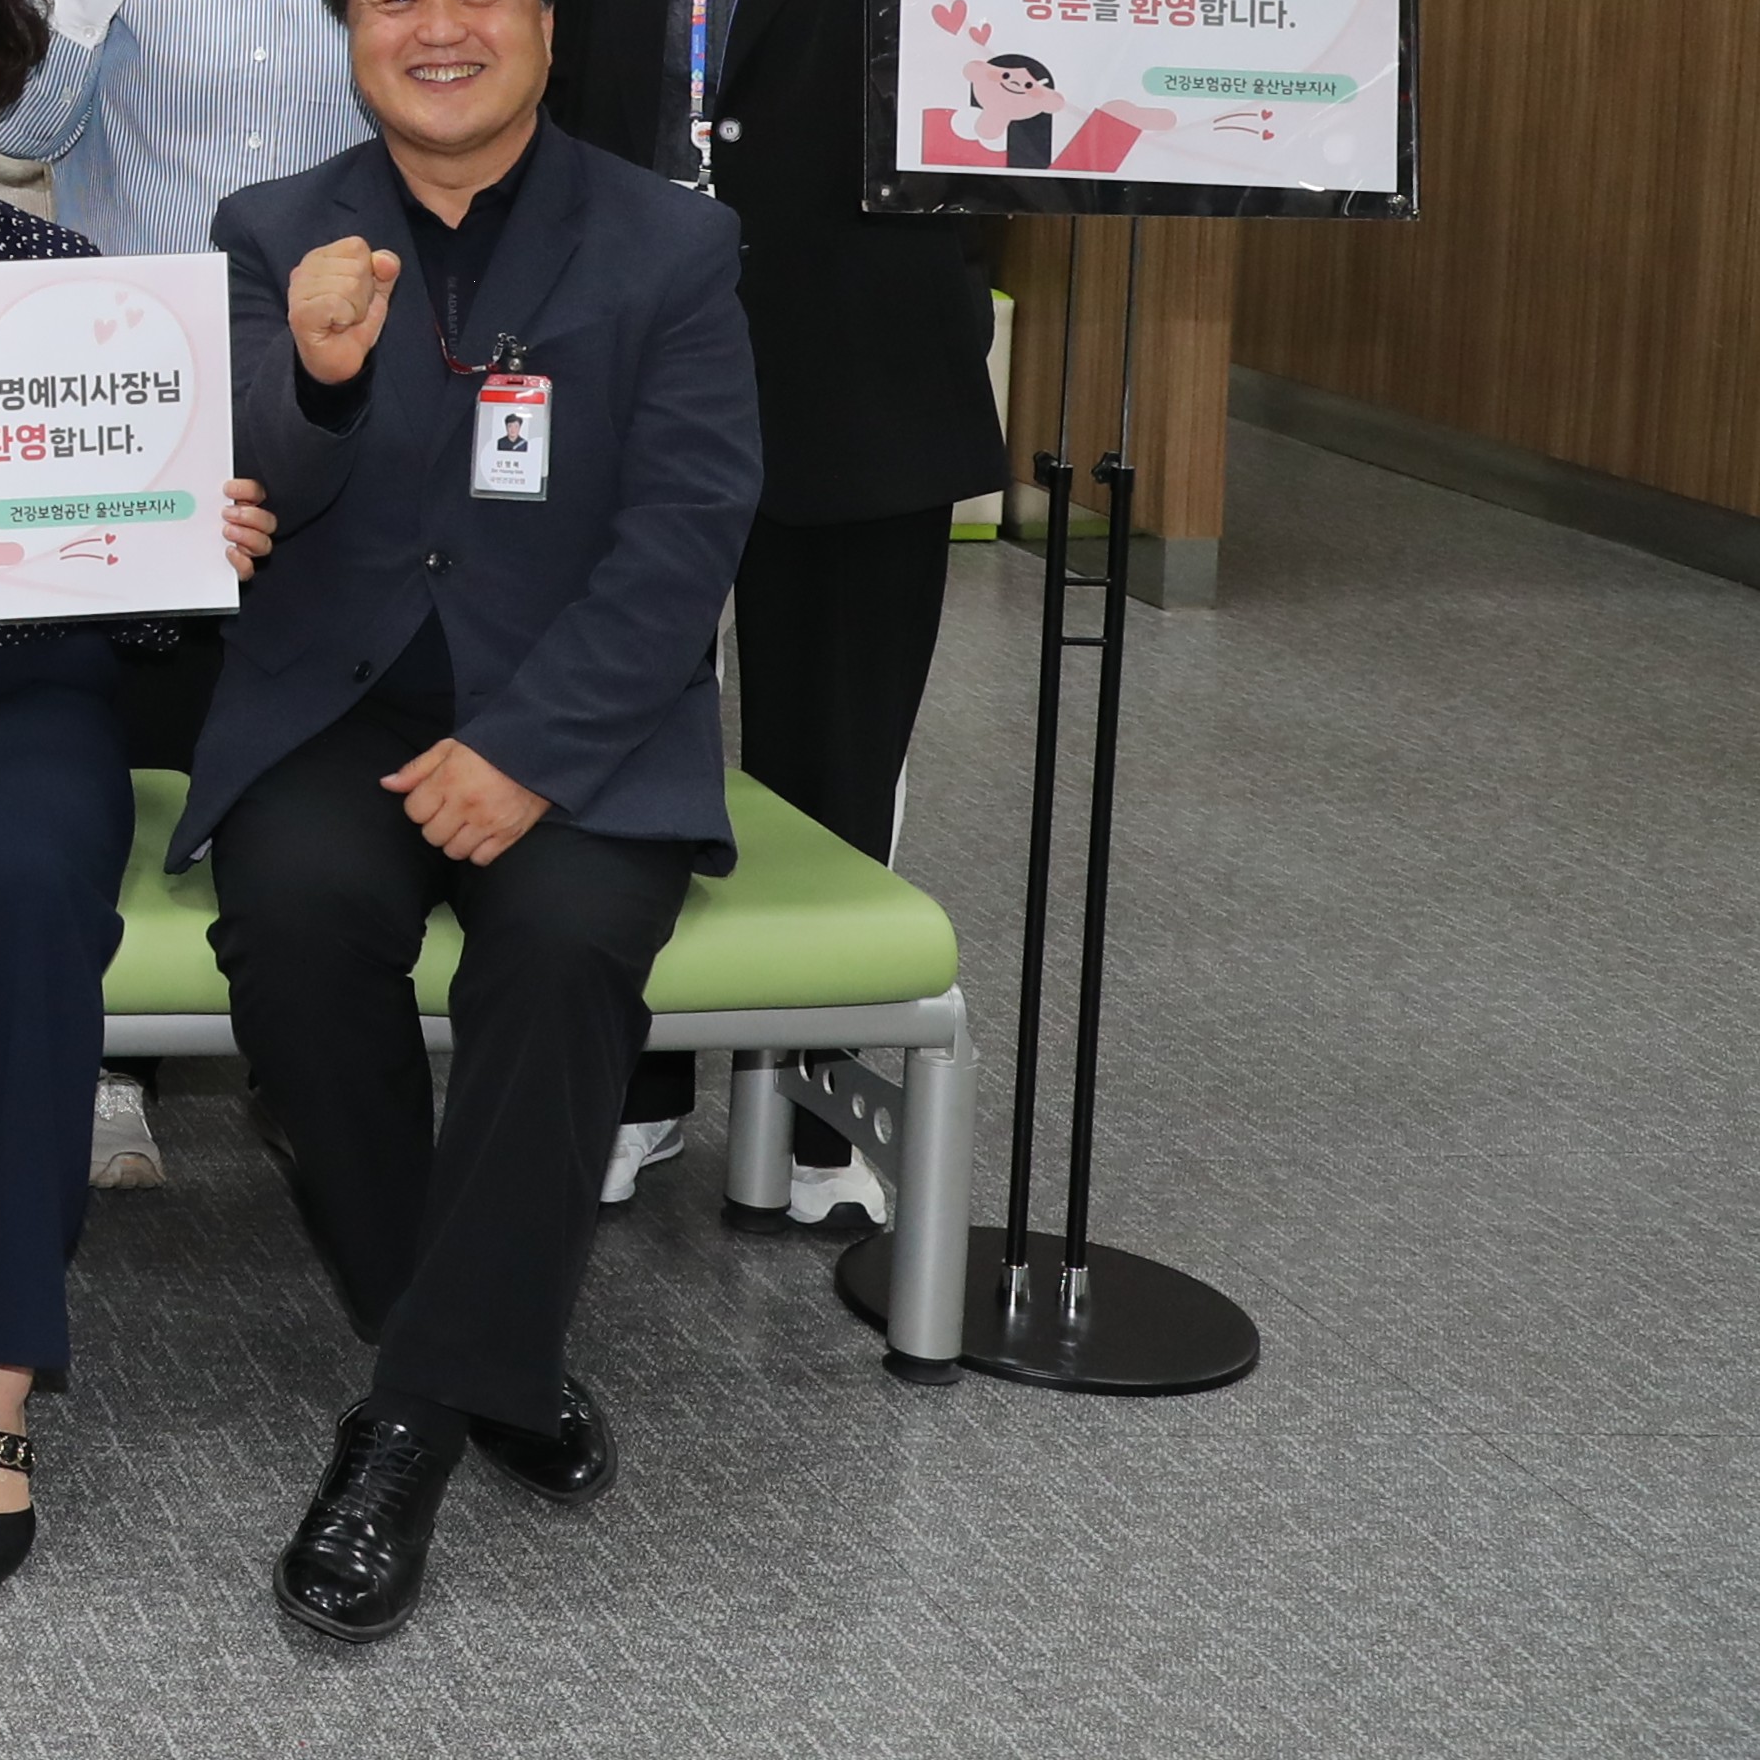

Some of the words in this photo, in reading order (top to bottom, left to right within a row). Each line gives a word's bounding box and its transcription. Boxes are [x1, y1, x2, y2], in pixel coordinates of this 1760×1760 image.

[1163, 73, 1247, 96] 건강보험공단
[1251, 75, 1337, 98] 울산남부지사
[9, 500, 91, 524] 건강보험공단
[94, 497, 177, 521] 울산남부지사
